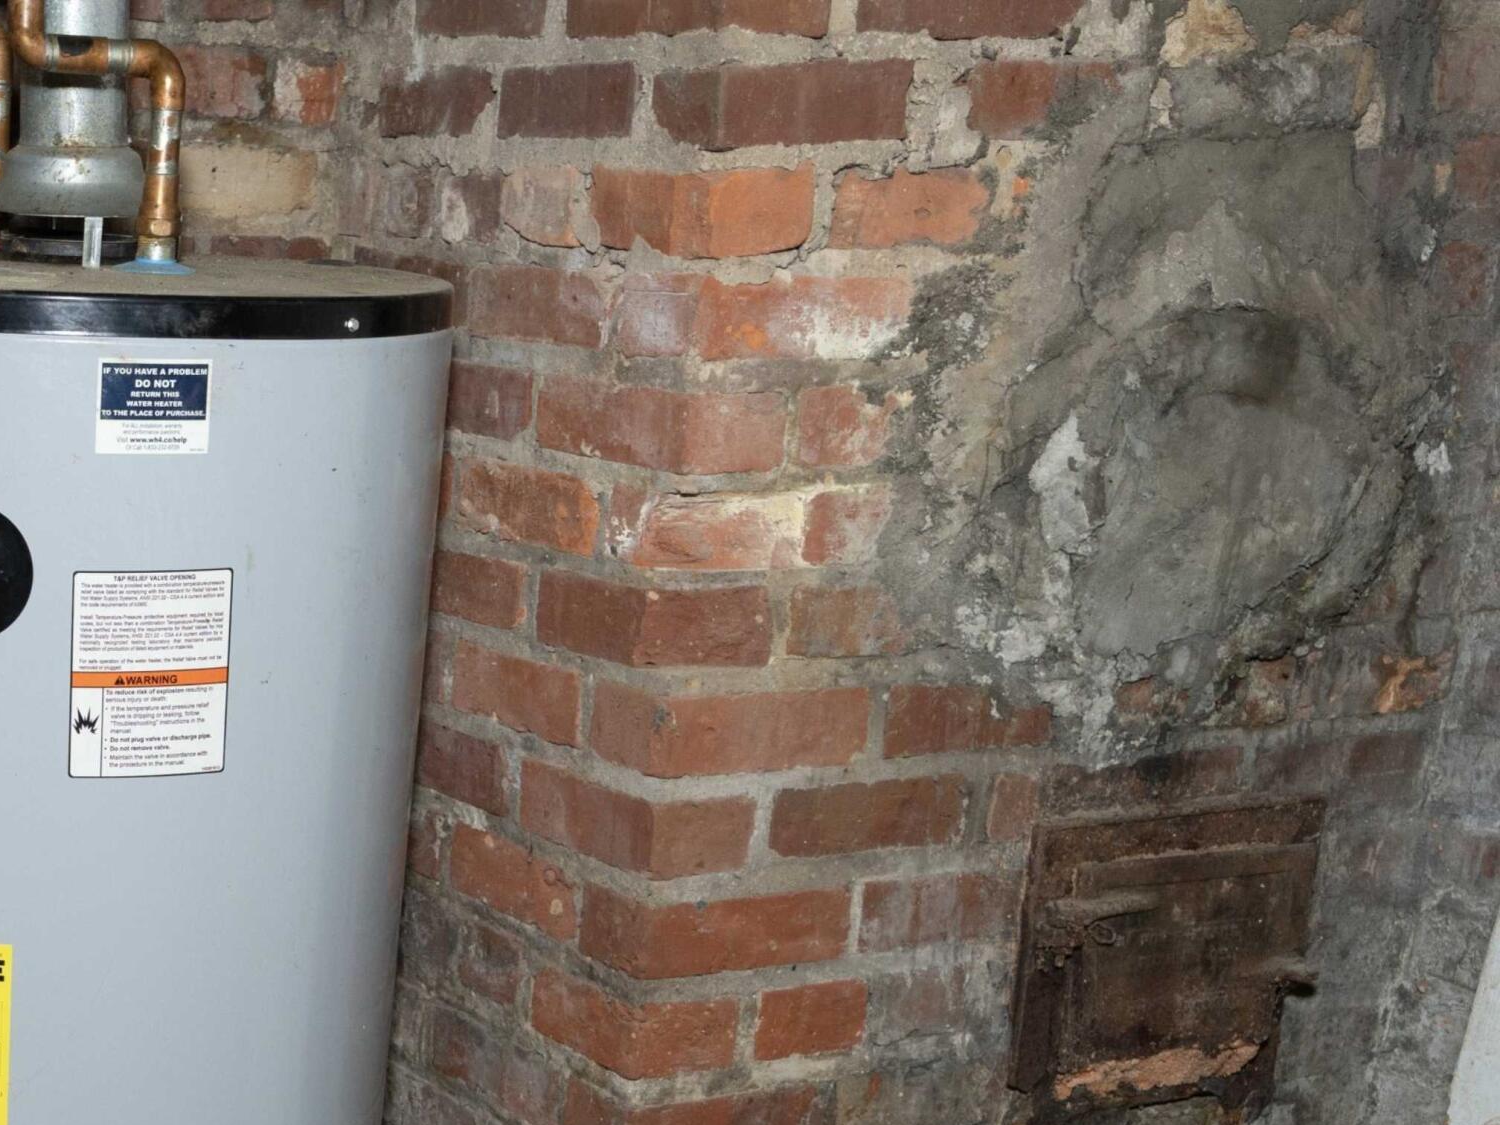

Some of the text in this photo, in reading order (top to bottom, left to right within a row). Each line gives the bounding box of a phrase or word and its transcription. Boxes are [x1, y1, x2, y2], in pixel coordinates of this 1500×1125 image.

[103, 367, 112, 375] IF
[114, 367, 132, 375] YOU
[168, 368, 208, 376] PROBLEM
[135, 379, 177, 388] DO NOT
[125, 675, 178, 685] WARNING
